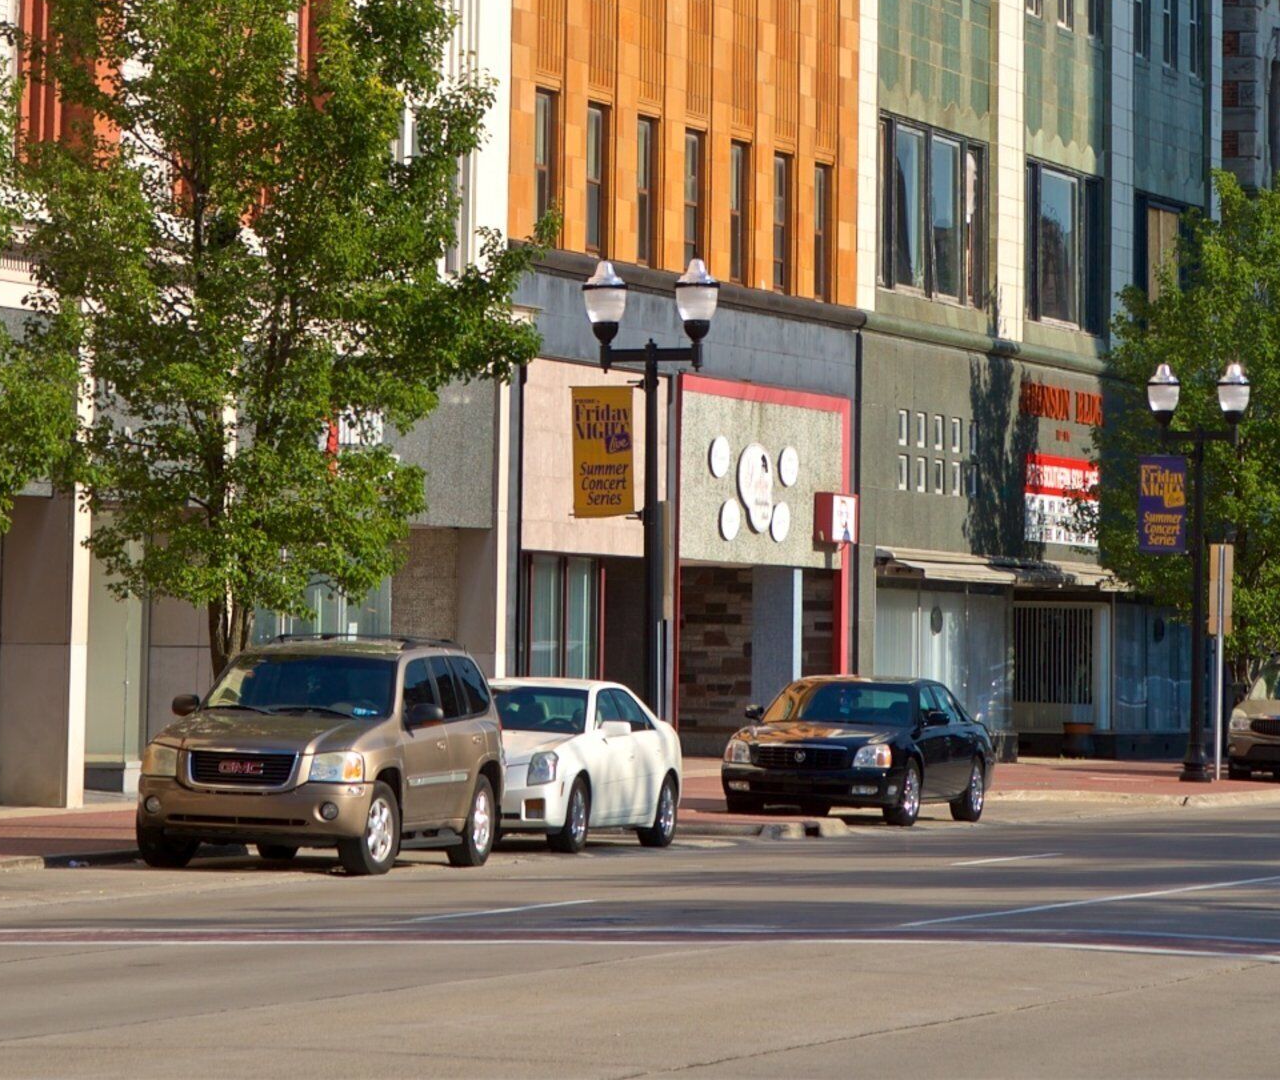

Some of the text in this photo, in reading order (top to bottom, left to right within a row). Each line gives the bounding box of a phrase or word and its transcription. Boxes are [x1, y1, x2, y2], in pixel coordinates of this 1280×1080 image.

[575, 404, 631, 422] Friday
[575, 422, 630, 439] NIGHT
[580, 462, 629, 476] Summer
[1140, 468, 1185, 484] Friday
[582, 477, 627, 491] Concert
[1140, 483, 1185, 497] NIGHT
[587, 491, 623, 505] Series
[1143, 511, 1183, 524] Summer
[1144, 523, 1180, 535] Concert
[1148, 534, 1177, 546] Series
[218, 761, 264, 773] GMC
